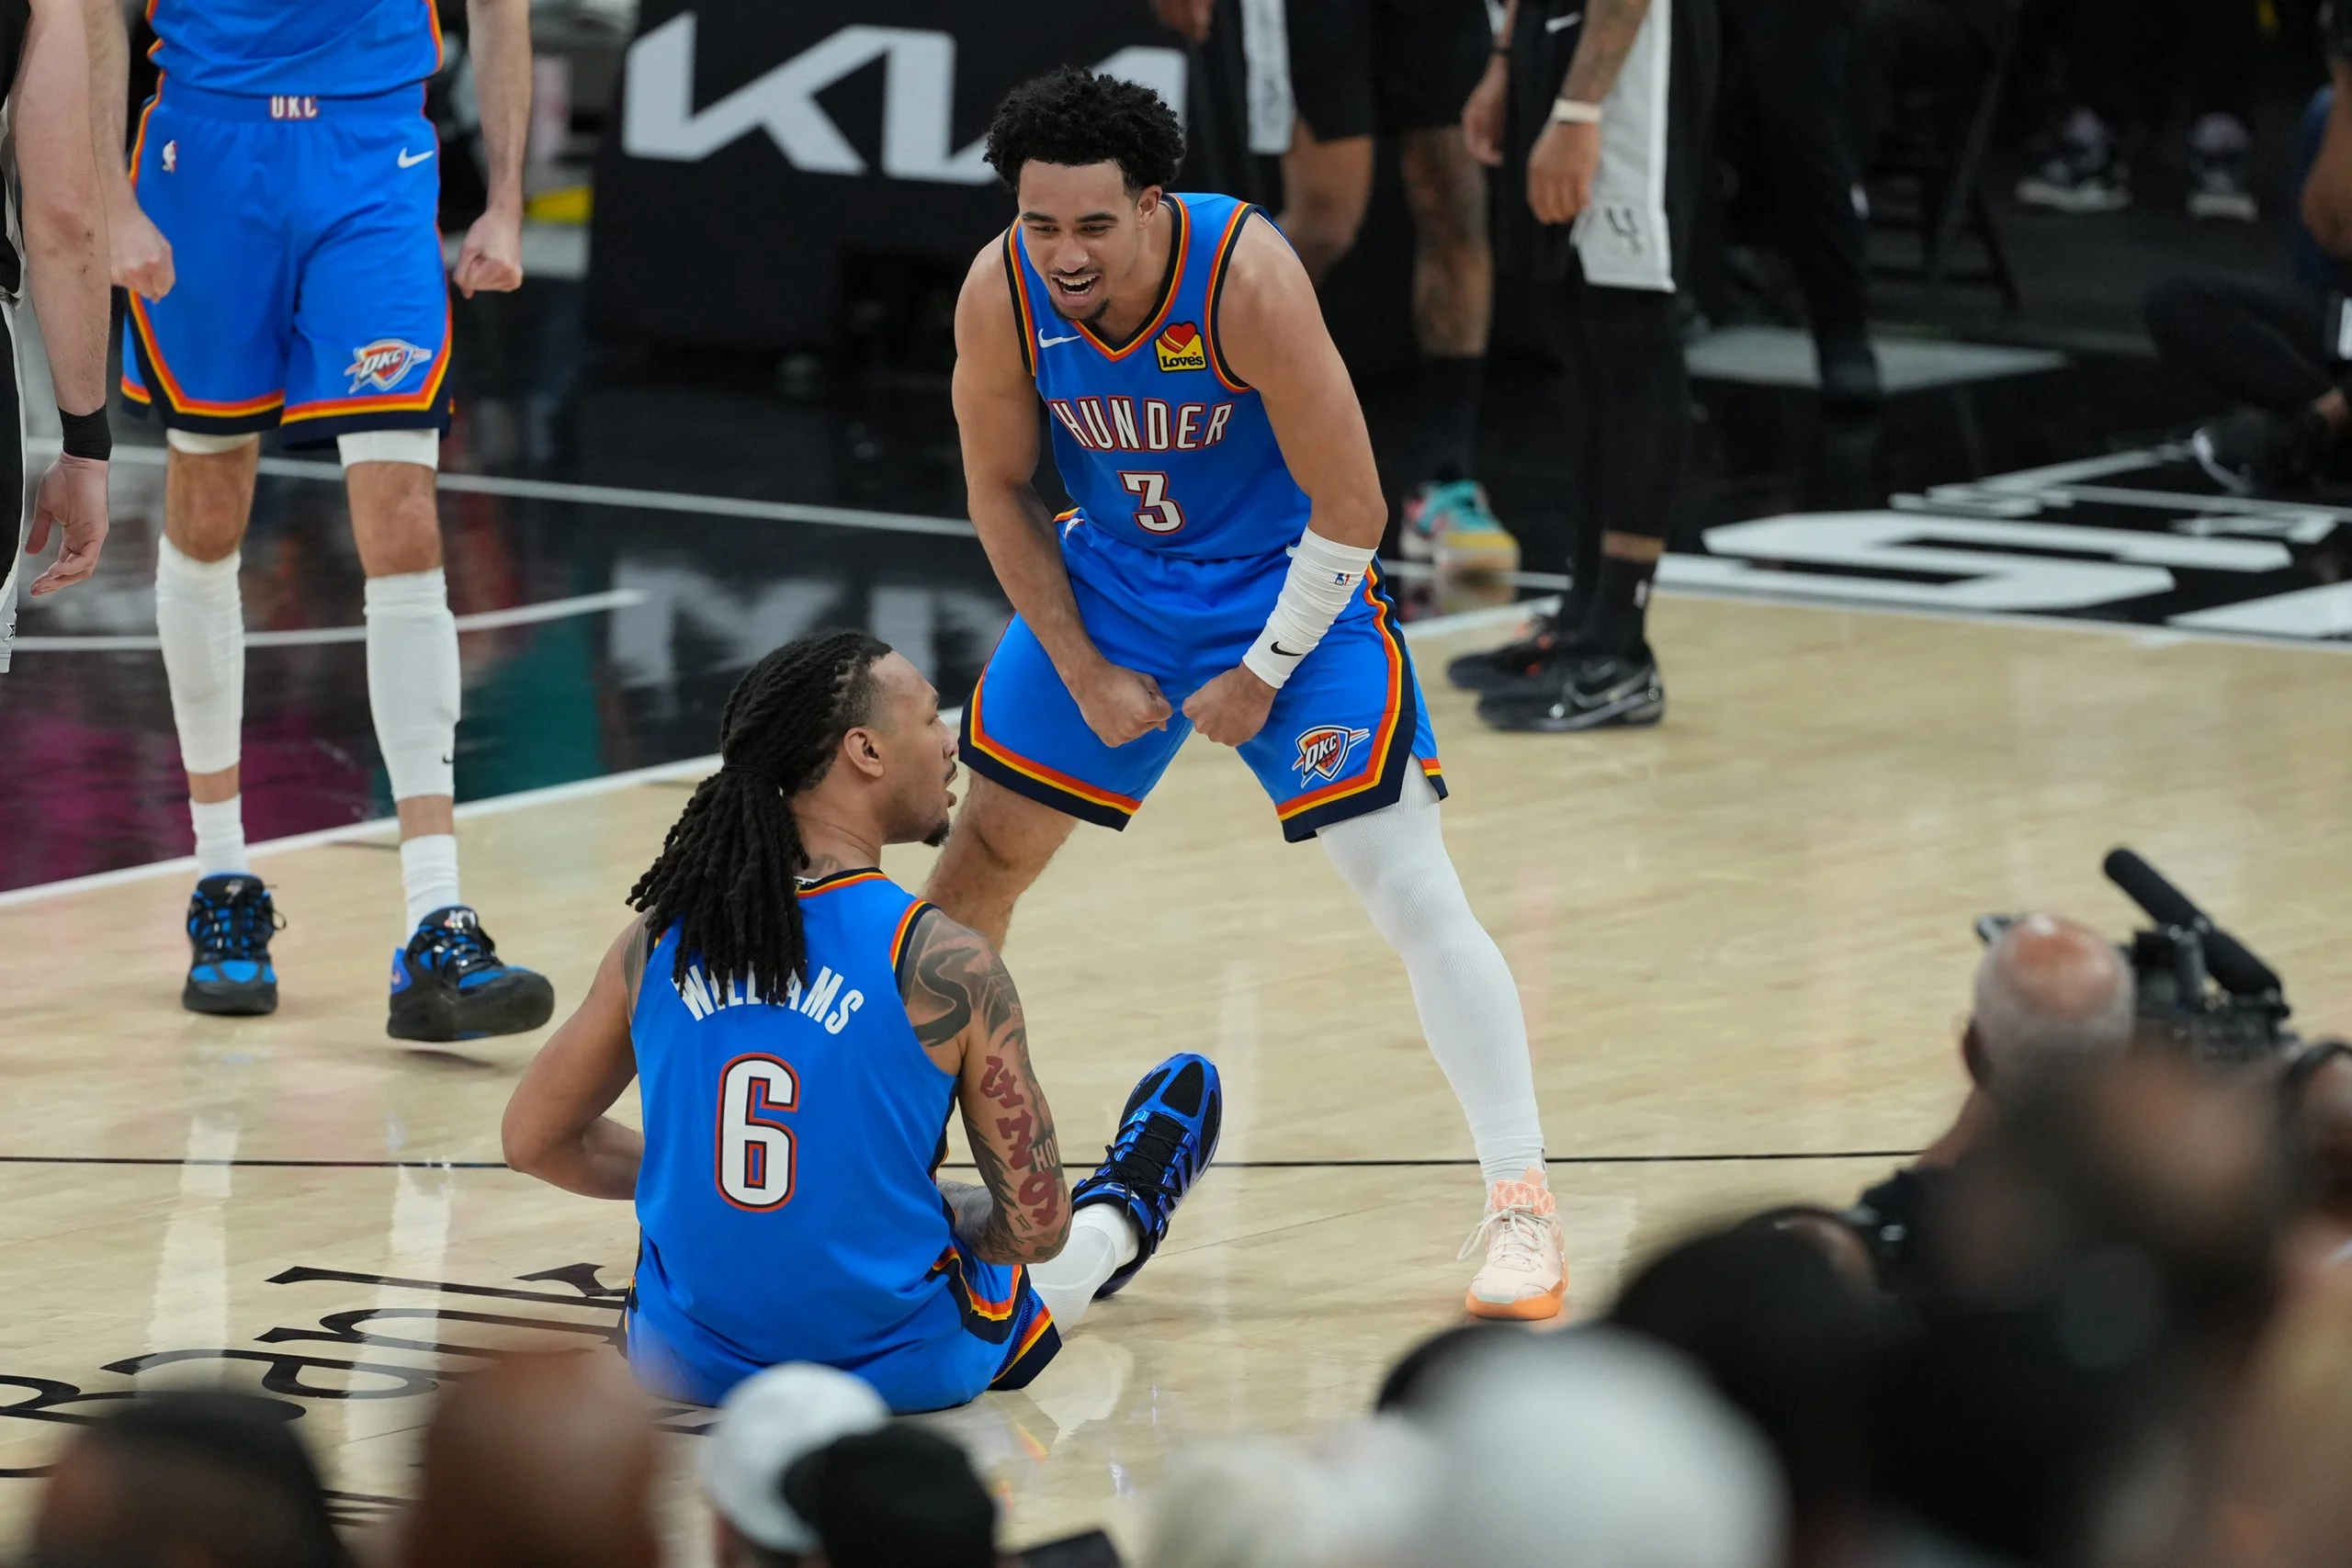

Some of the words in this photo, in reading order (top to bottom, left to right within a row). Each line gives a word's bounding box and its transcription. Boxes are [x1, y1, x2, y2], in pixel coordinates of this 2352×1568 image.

[359, 349, 402, 379] OKC
[1048, 396, 1235, 452] HUNDER
[1116, 470, 1186, 535] 3
[1304, 735, 1338, 773] OKC
[670, 959, 865, 1035] WILLAMS
[715, 1052, 800, 1213] 6
